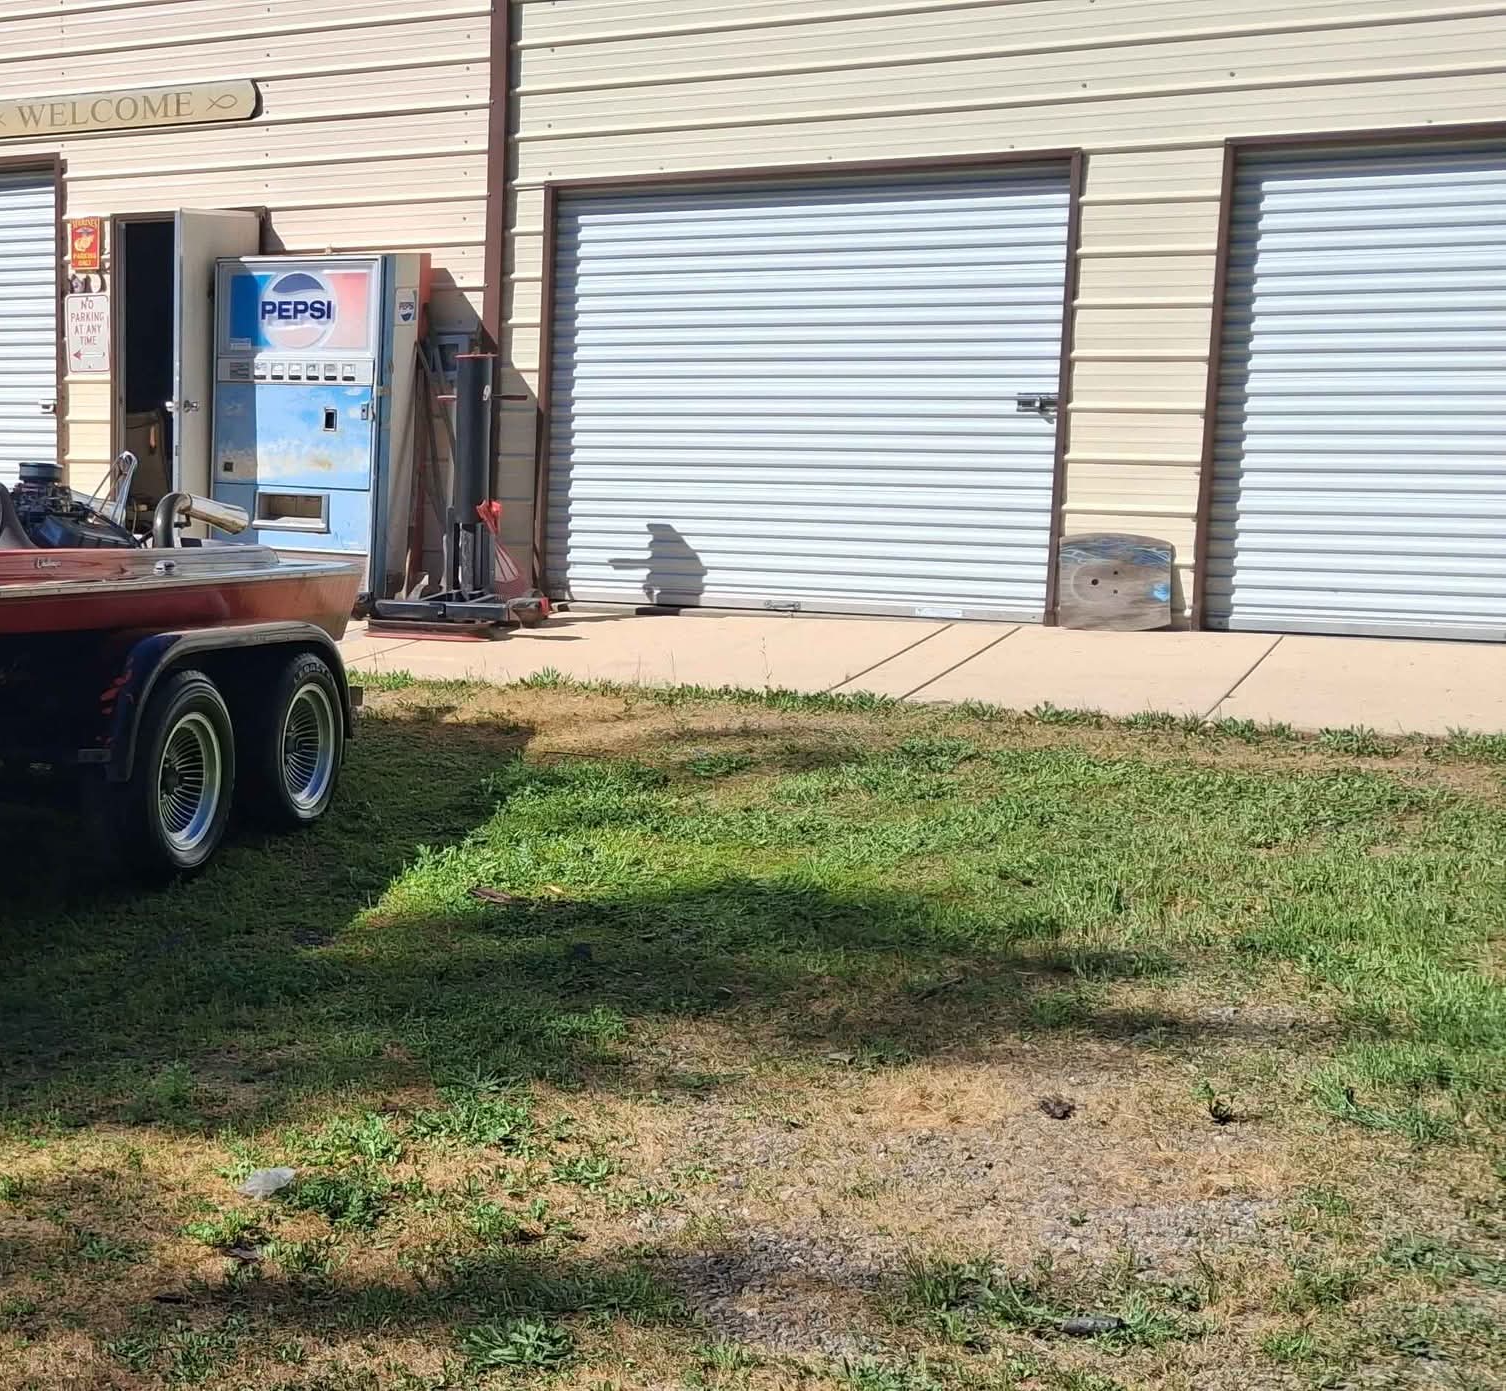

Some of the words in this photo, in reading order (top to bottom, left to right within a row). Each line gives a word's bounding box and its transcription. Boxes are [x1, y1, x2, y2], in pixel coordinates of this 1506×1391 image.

[17, 91, 194, 128] WELCOME
[81, 300, 94, 309] NO
[261, 301, 332, 320] PEPSI
[71, 312, 104, 321] PARKING
[74, 325, 84, 335] AT
[86, 324, 101, 334] ANY
[80, 336, 97, 345] TIME
